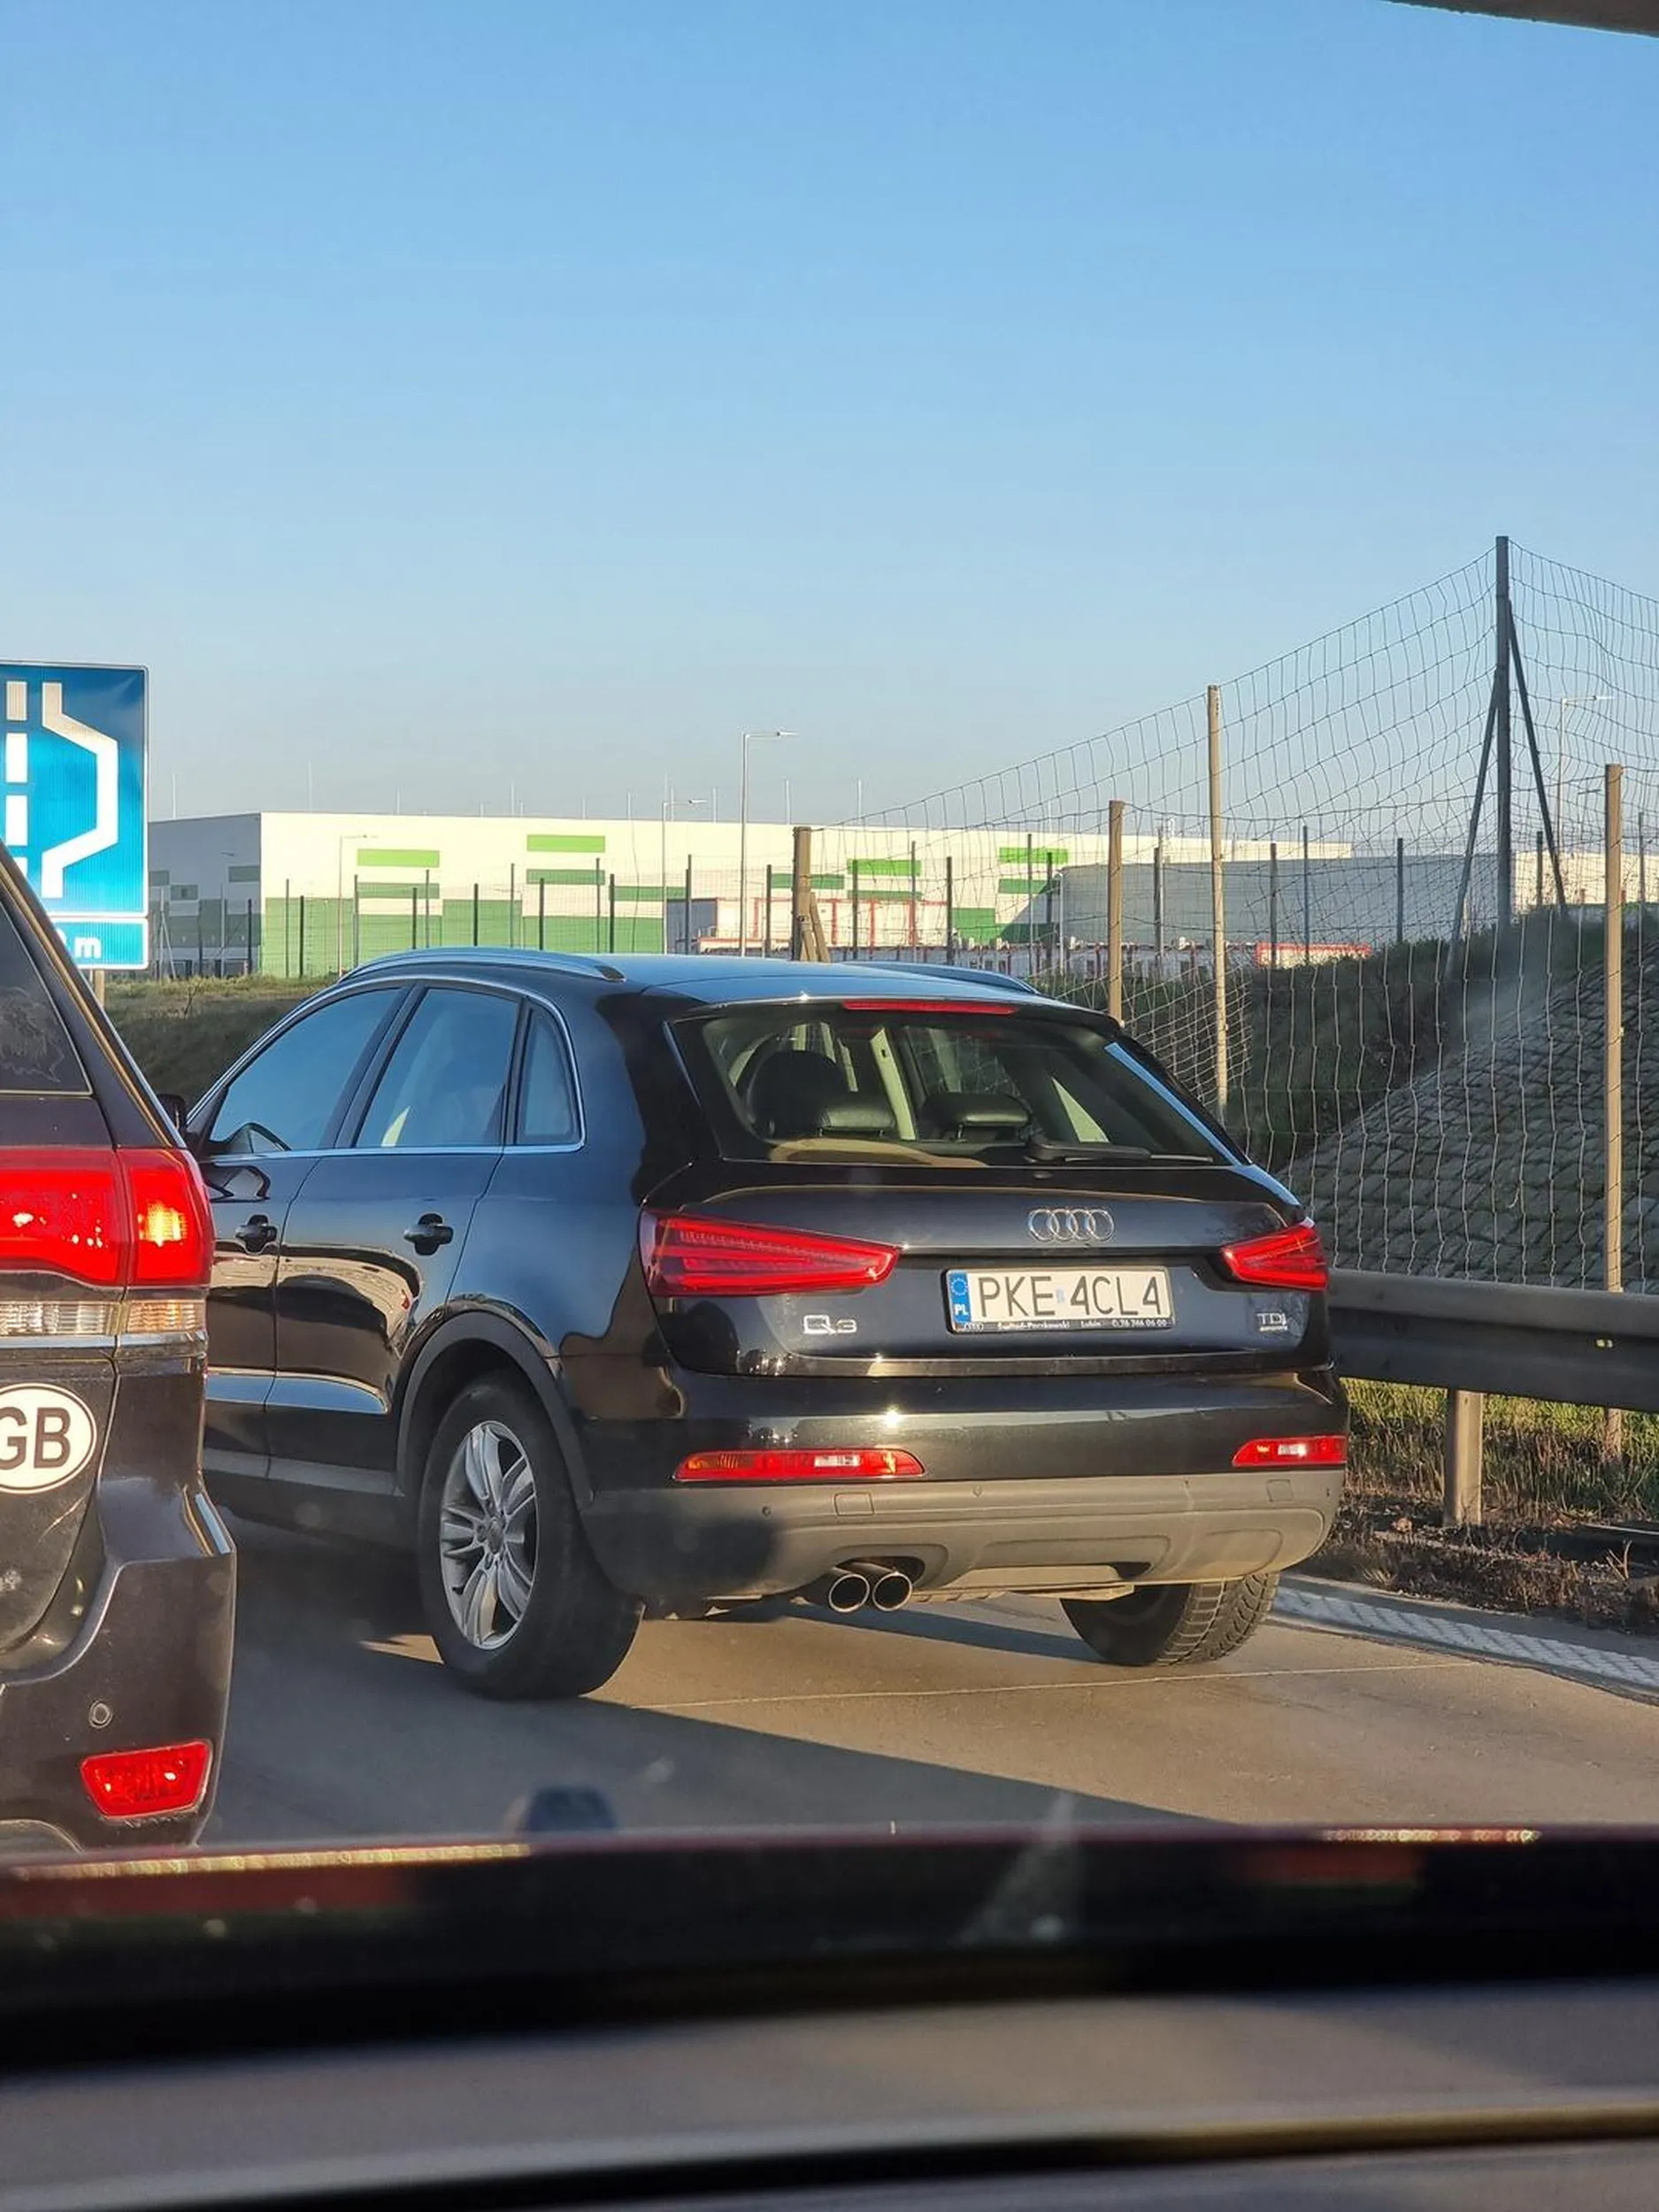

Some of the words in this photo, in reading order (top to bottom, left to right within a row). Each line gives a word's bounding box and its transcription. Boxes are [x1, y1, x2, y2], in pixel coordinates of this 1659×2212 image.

[74, 936, 102, 959] m
[978, 1276, 1056, 1317] PKE
[1070, 1276, 1161, 1317] 4CL4
[954, 1304, 969, 1317] PL
[1256, 1312, 1287, 1325] TDI
[803, 1315, 857, 1334] Q3
[0, 1407, 71, 1470] GB
